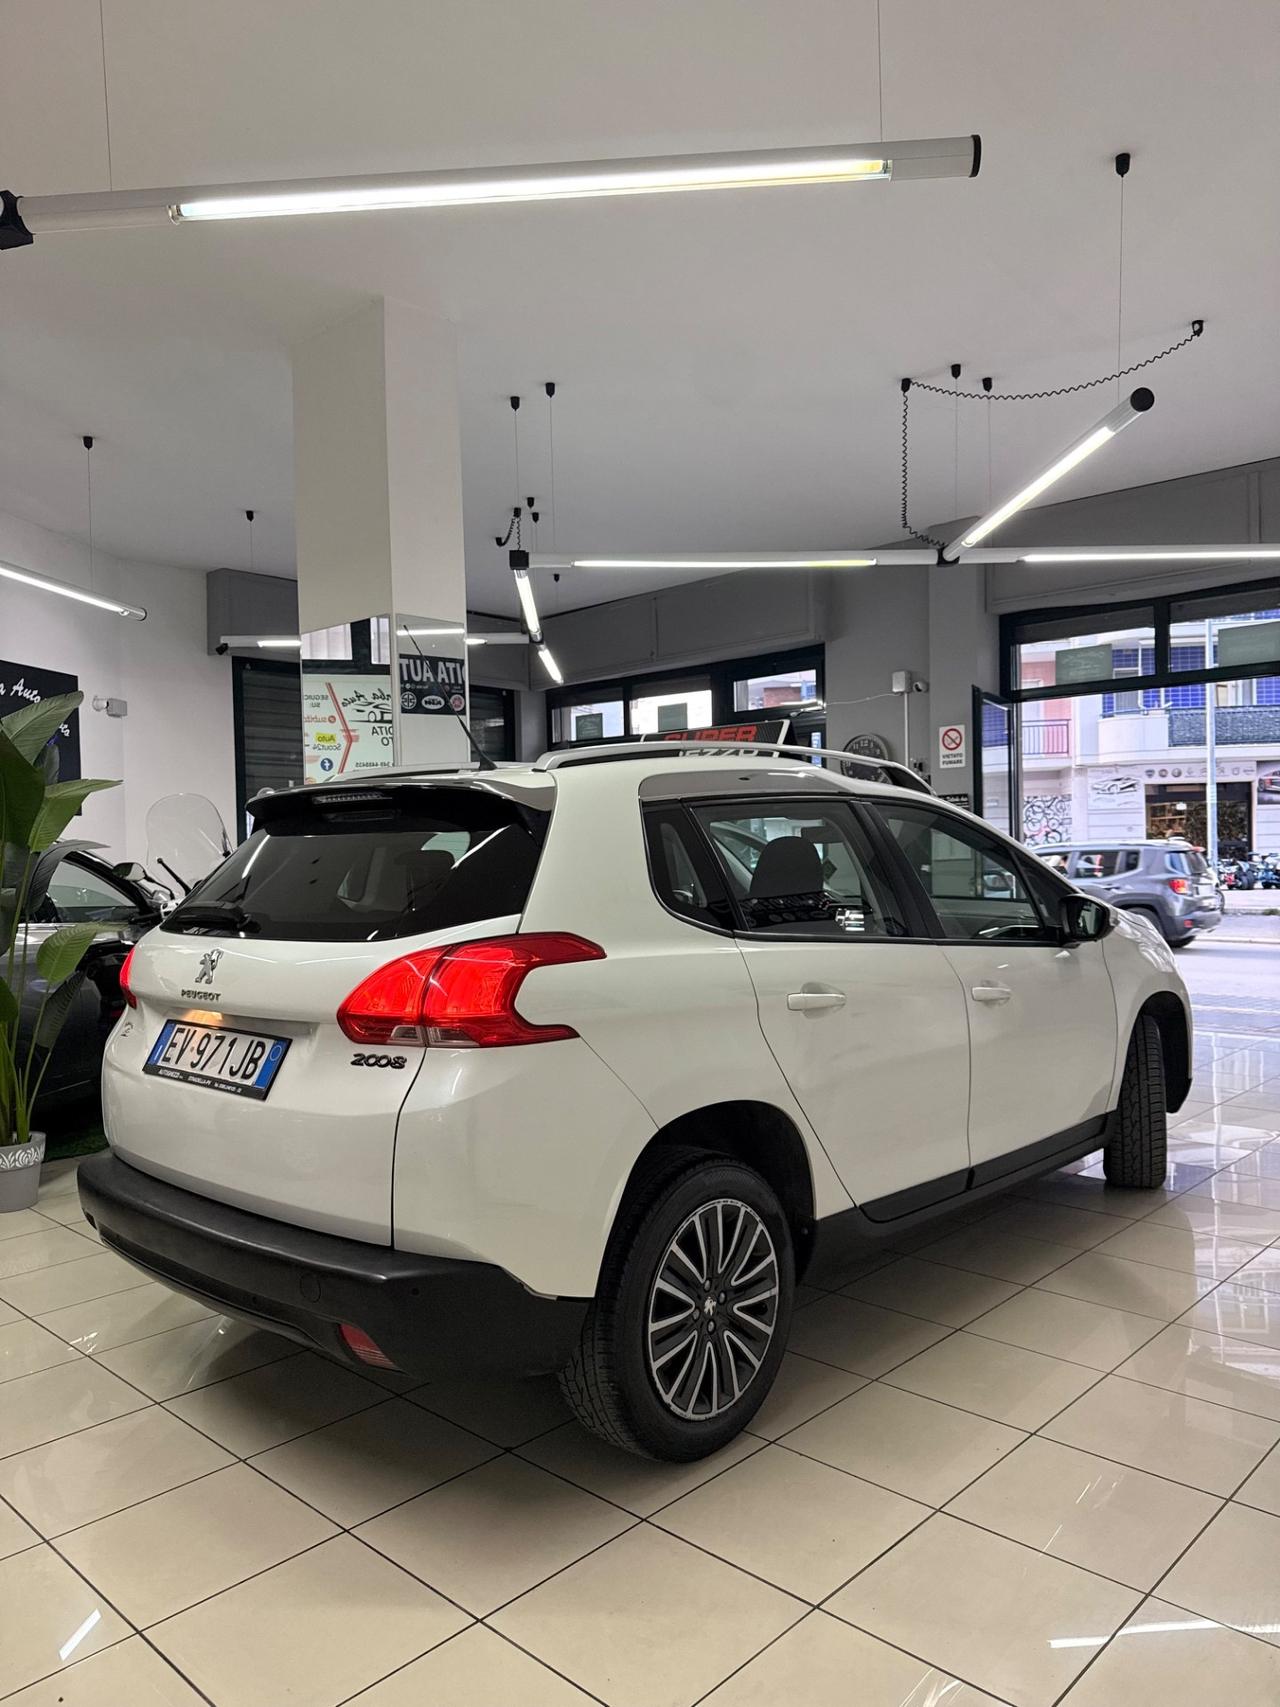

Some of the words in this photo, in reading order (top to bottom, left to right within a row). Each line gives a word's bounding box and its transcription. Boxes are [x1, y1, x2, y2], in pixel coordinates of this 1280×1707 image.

[10, 678, 41, 703] Auto
[181, 989, 221, 1001] PEUGEOT
[350, 1053, 408, 1069] 2008
